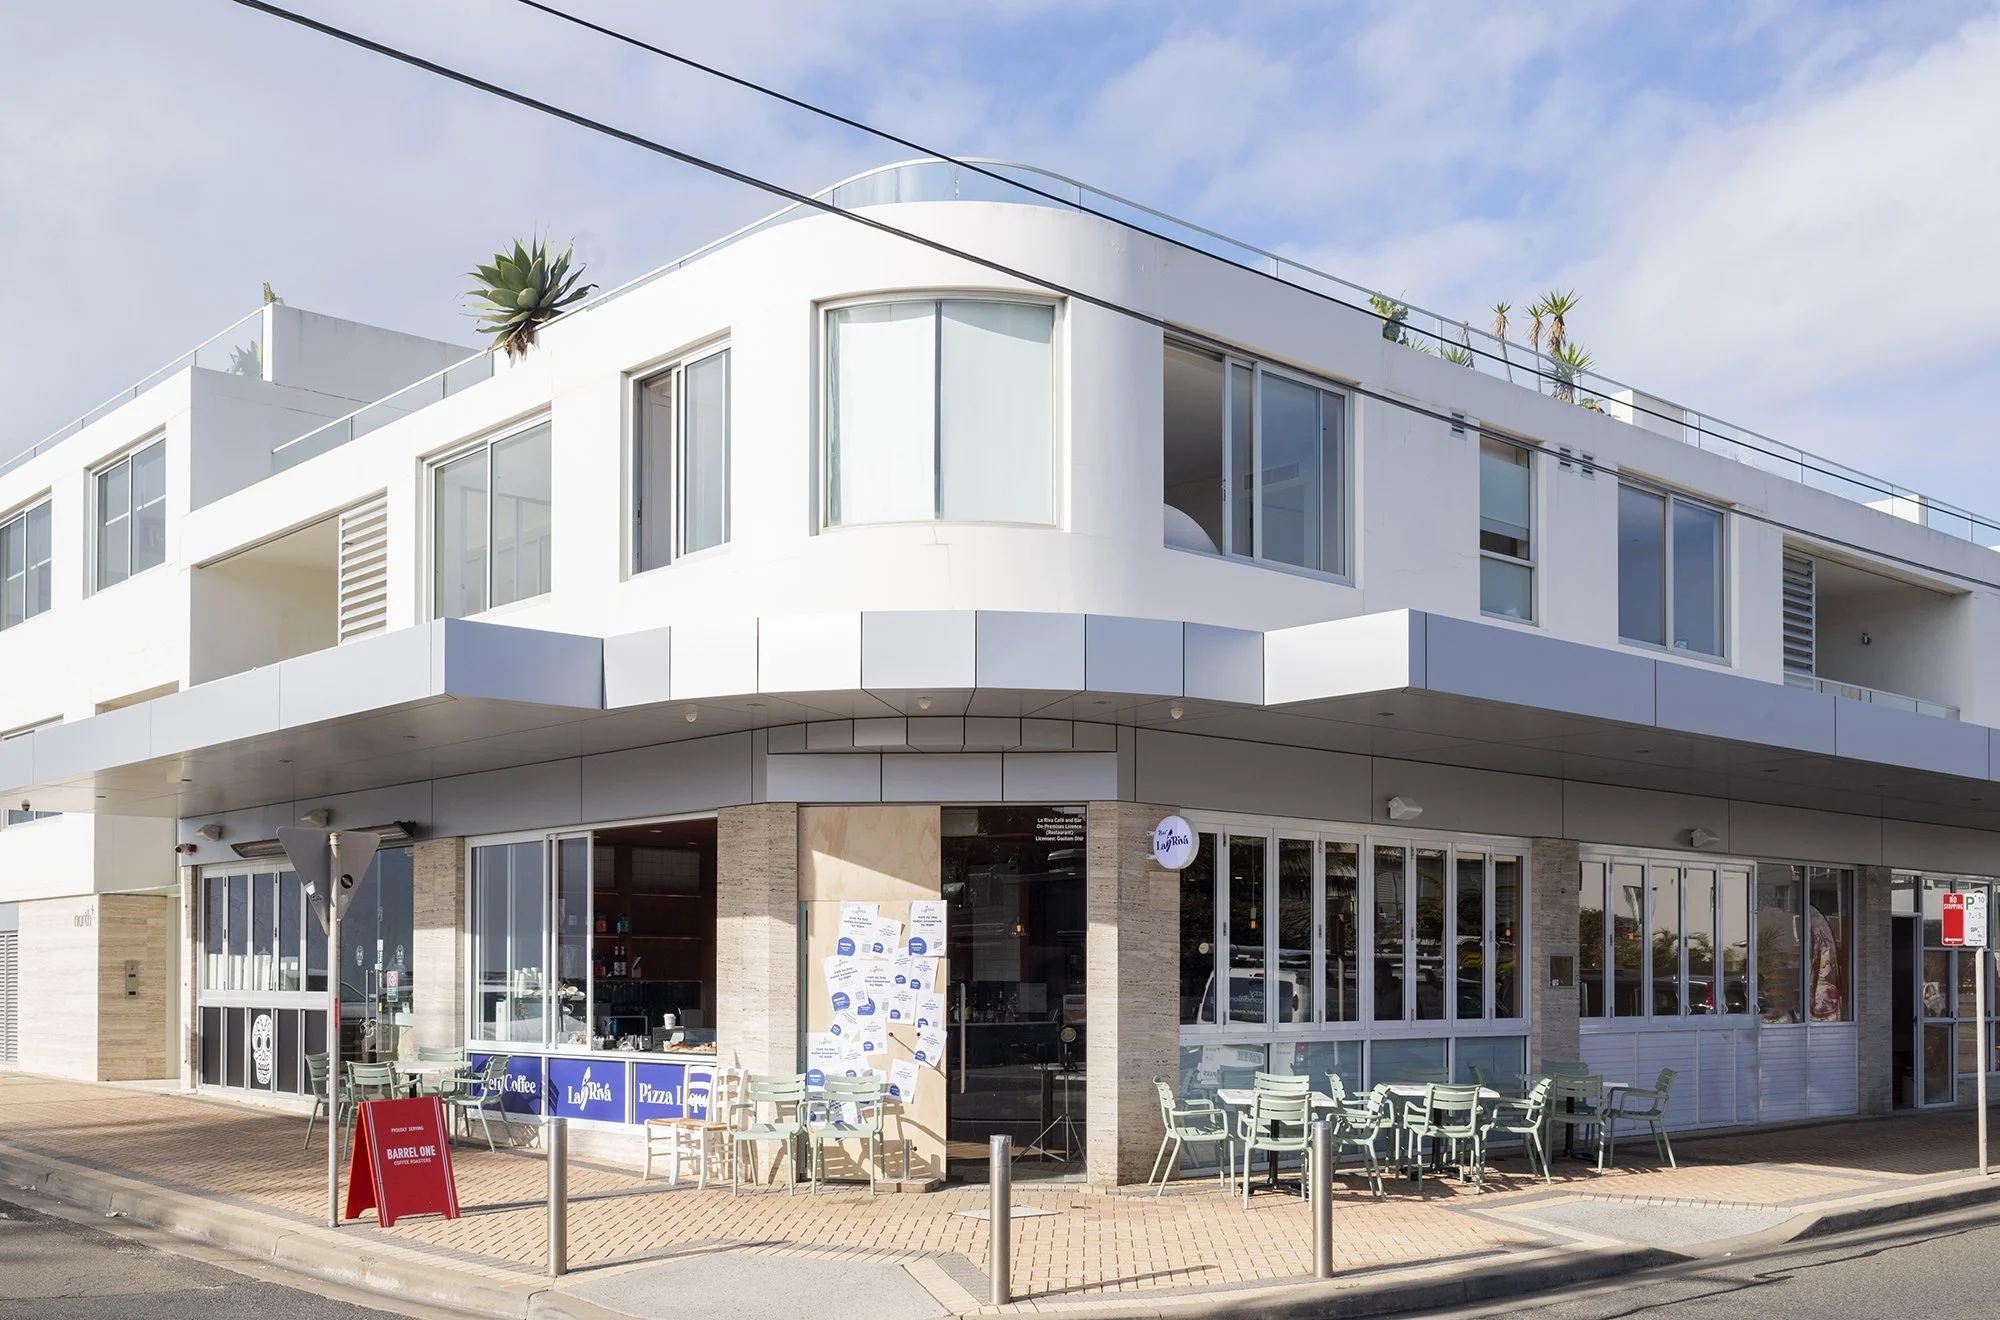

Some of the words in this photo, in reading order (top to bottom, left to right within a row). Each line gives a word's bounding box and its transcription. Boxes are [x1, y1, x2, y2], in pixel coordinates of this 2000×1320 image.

[1966, 896, 1975, 910] P
[505, 1074, 536, 1093] Coffee
[568, 1086, 582, 1104] La
[638, 1083, 674, 1105] Pizza
[386, 1147, 418, 1160] BARREL
[420, 1145, 436, 1157] ONE
